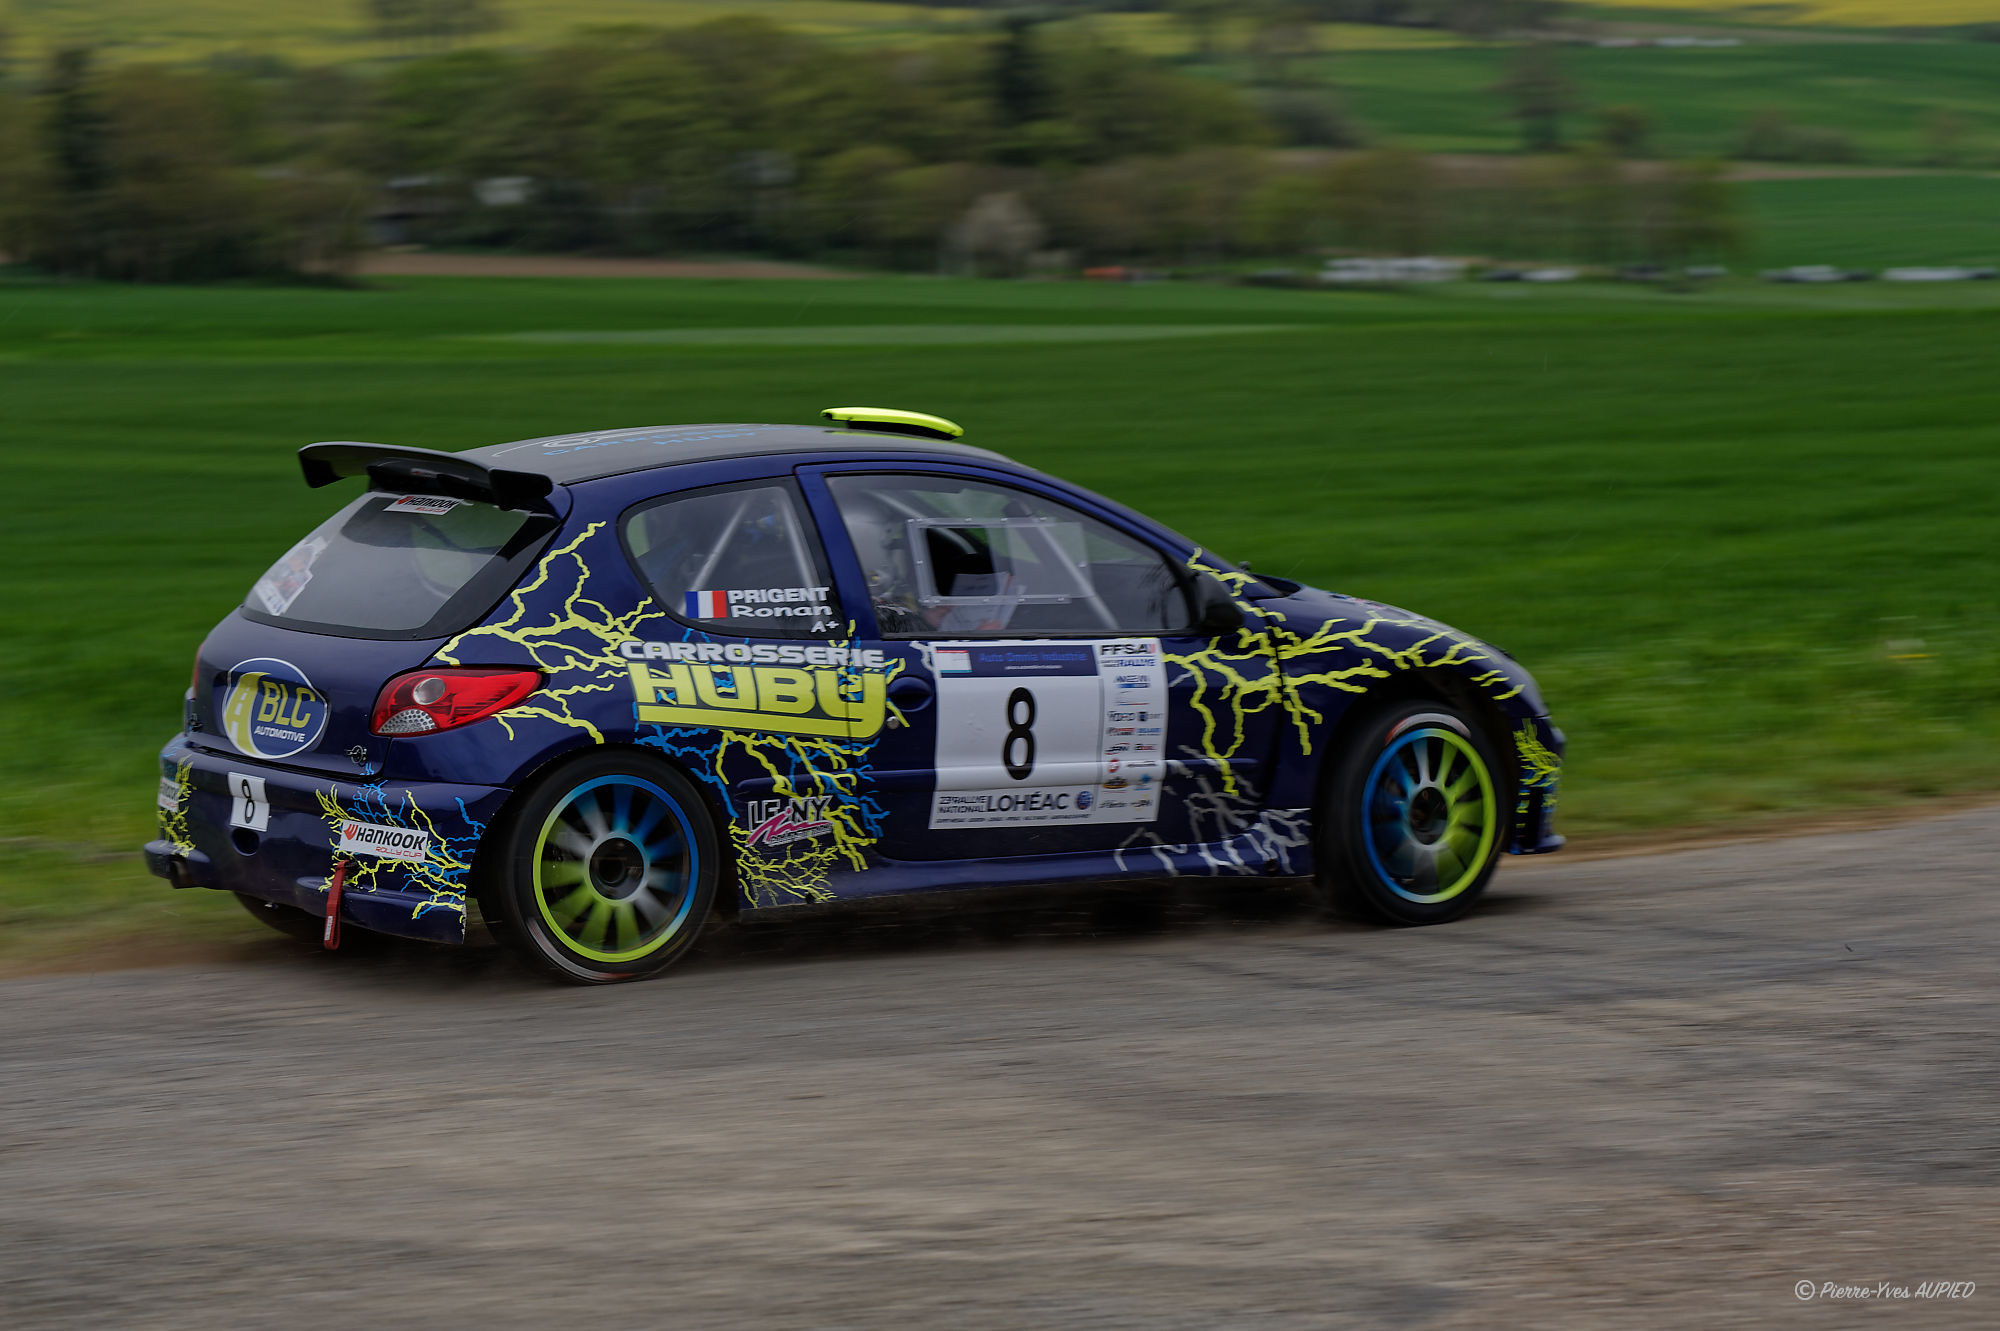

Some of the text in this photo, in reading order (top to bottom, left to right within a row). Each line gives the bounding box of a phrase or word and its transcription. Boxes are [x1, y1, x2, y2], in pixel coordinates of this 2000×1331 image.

[727, 587, 830, 604] PRIGENT
[730, 605, 833, 618] Ronan
[811, 620, 840, 633] A+
[621, 641, 885, 668] CARROSSERIE
[1101, 644, 1148, 656] FFSA
[257, 680, 316, 729] BLC
[626, 662, 887, 739] HUBY
[254, 725, 306, 743] AUTOMOTIVE
[1003, 686, 1036, 781] 8
[241, 778, 255, 824] 8
[938, 804, 986, 814] NATIONAL
[986, 791, 1070, 813] LOHÉAC
[402, 850, 423, 858] CUP
